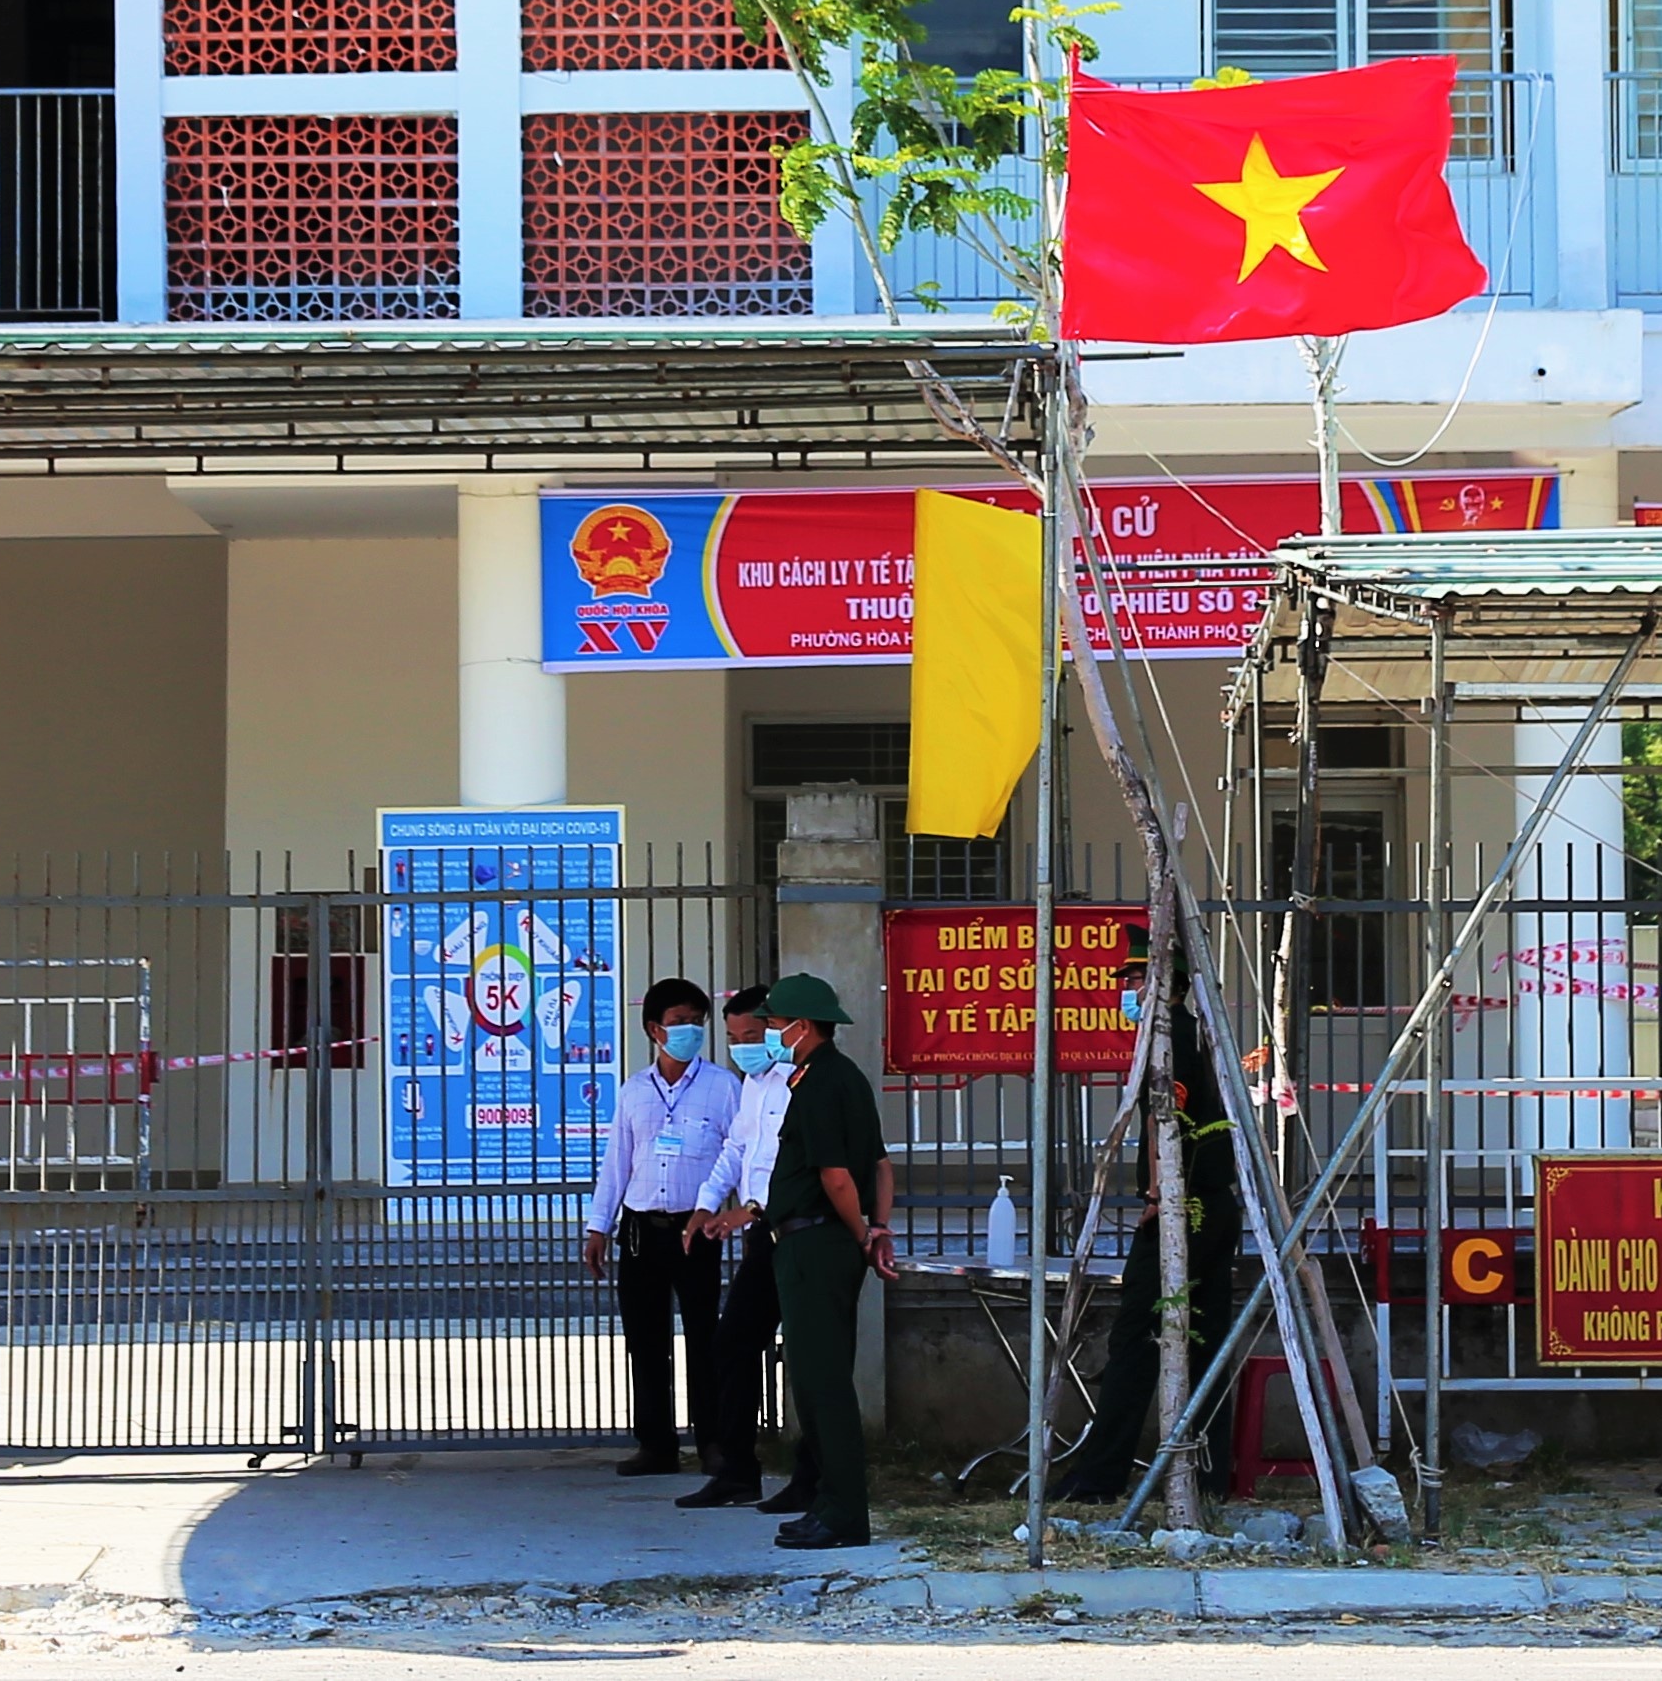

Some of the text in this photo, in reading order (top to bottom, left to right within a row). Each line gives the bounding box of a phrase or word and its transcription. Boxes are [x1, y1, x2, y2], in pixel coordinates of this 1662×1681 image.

[738, 551, 914, 596] KHU CÁCH LY Y TẾ TẬ
[577, 603, 609, 618] QUỐC
[612, 603, 633, 618] HỘI
[845, 593, 914, 625] THUỘ
[576, 621, 669, 654] XV
[791, 631, 862, 649] PHƯỜNG
[867, 631, 900, 647] HÒA
[1146, 622, 1199, 641] THÀNH
[390, 824, 425, 838] CHUNG
[457, 823, 472, 836] AN
[566, 822, 612, 835] COVID-19
[938, 917, 1121, 950] ĐIỂM BU CỬ
[903, 968, 944, 997] TẠI
[954, 964, 991, 991] CƠ
[999, 958, 1036, 991] SỞ
[486, 985, 520, 1010] 5K
[922, 1010, 937, 1033] Y
[946, 1001, 978, 1032] TẾ
[986, 1003, 1035, 1037] TẬP
[1452, 1237, 1505, 1295] C
[1554, 1227, 1611, 1292] DÀNH
[1617, 1238, 1658, 1292] CHO
[1584, 1305, 1650, 1341] KHÔNG
